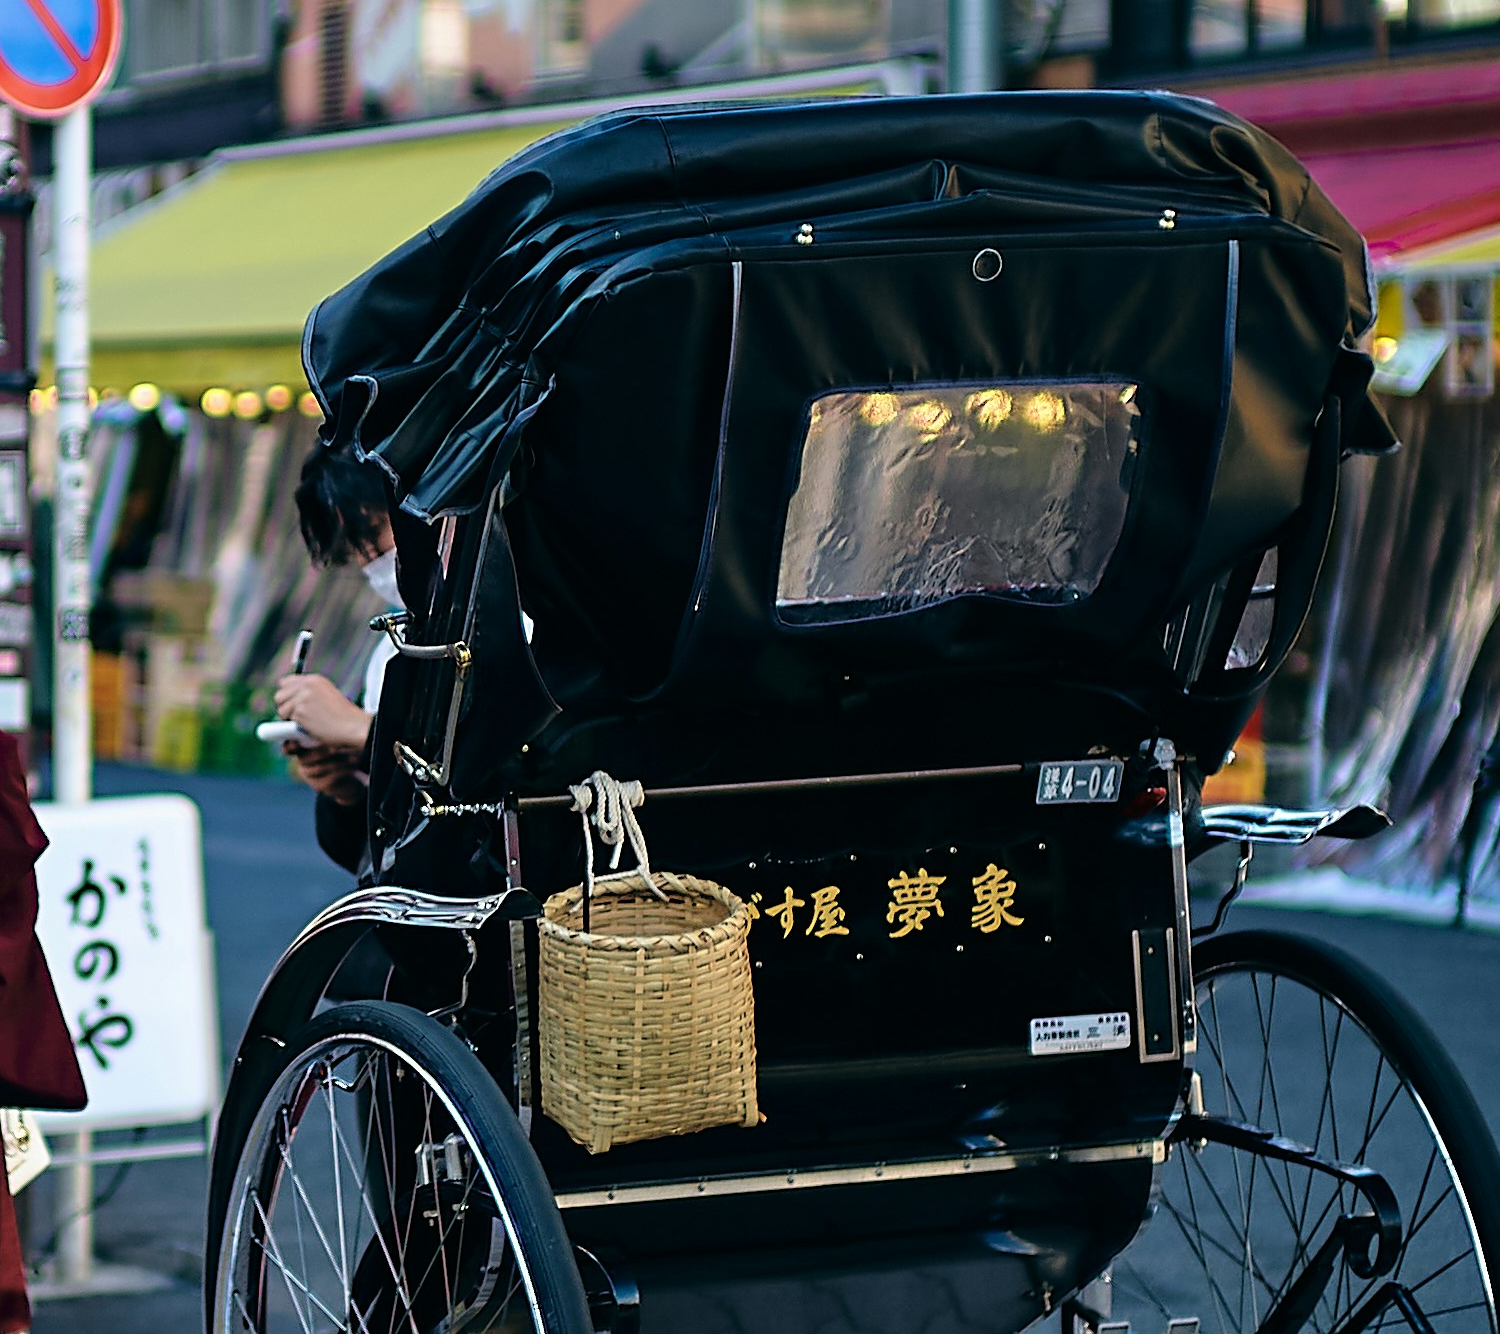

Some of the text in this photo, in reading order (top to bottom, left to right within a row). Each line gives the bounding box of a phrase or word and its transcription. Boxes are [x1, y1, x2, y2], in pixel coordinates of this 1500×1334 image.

[1060, 765, 1117, 799] 4-04
[64, 857, 135, 1071] かのや
